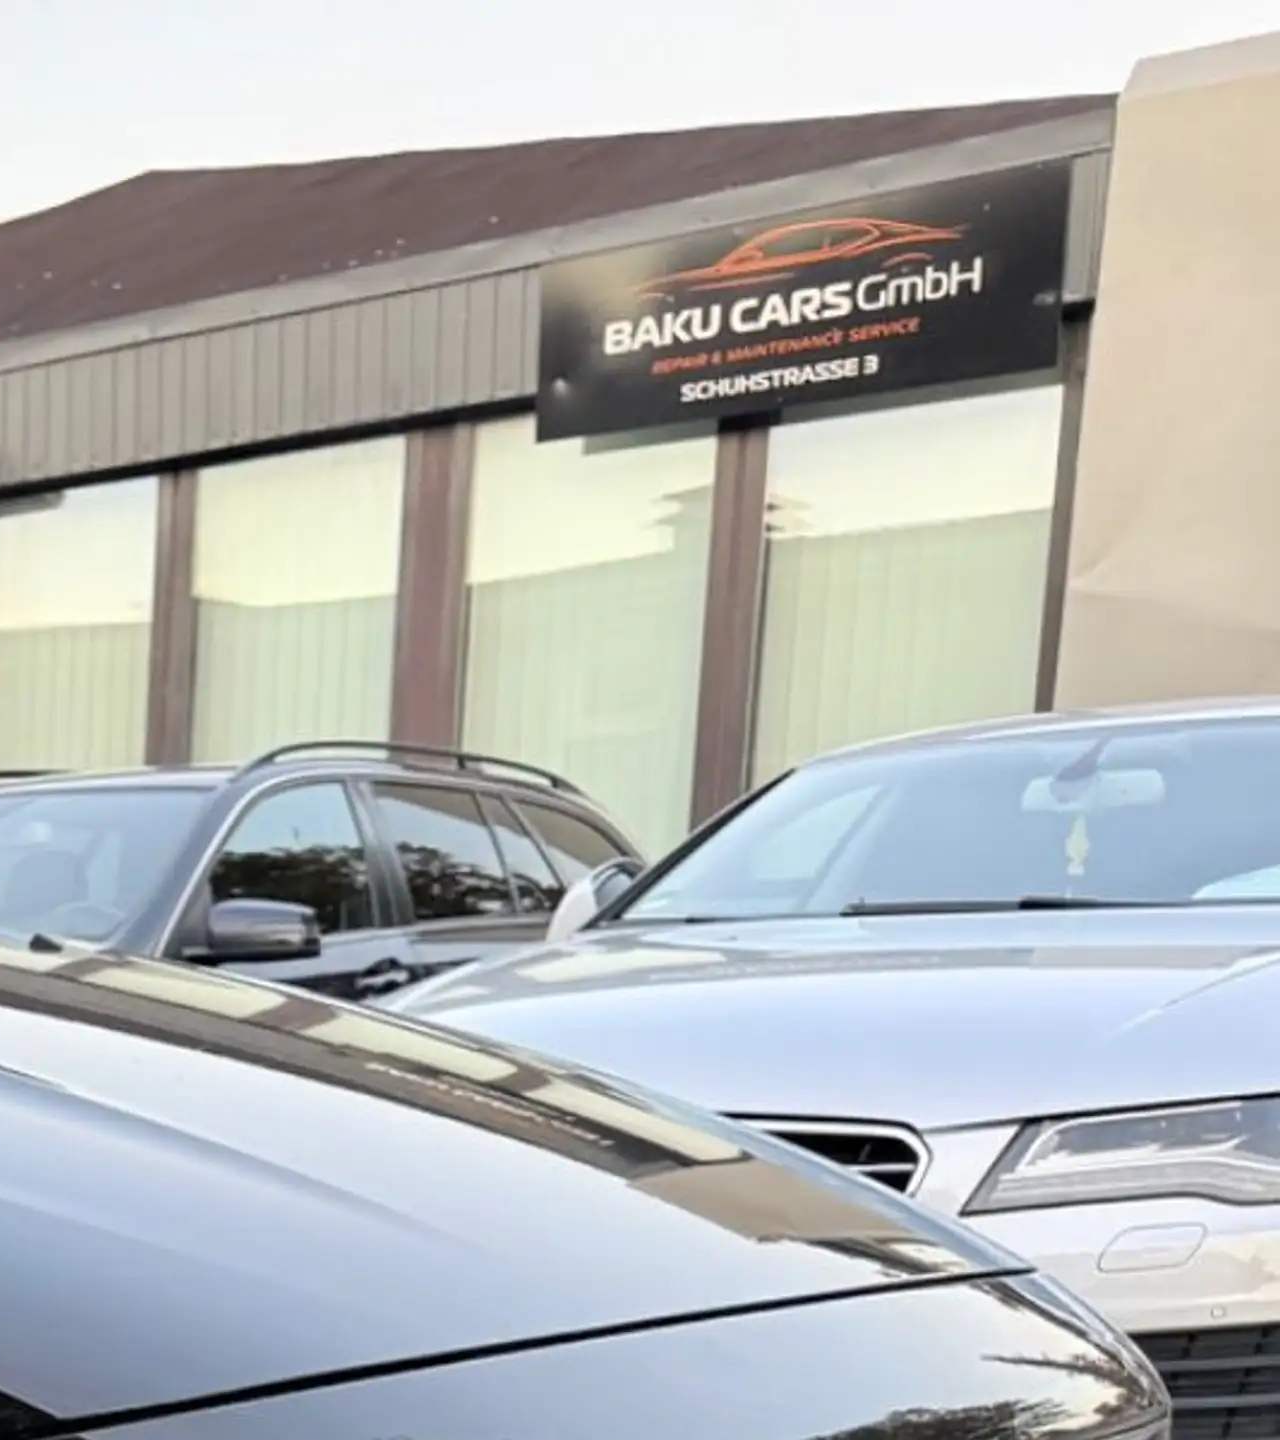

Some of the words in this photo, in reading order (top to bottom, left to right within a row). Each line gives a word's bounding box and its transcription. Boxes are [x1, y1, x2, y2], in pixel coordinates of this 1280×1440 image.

[603, 303, 722, 356] BAKU
[729, 280, 853, 334] CARS
[856, 255, 984, 312] GmbH
[725, 326, 842, 365] MAINTENANCE
[848, 316, 922, 343] SERVICE
[680, 357, 860, 403] SCHUHSTRASSE
[863, 353, 881, 376] 3
